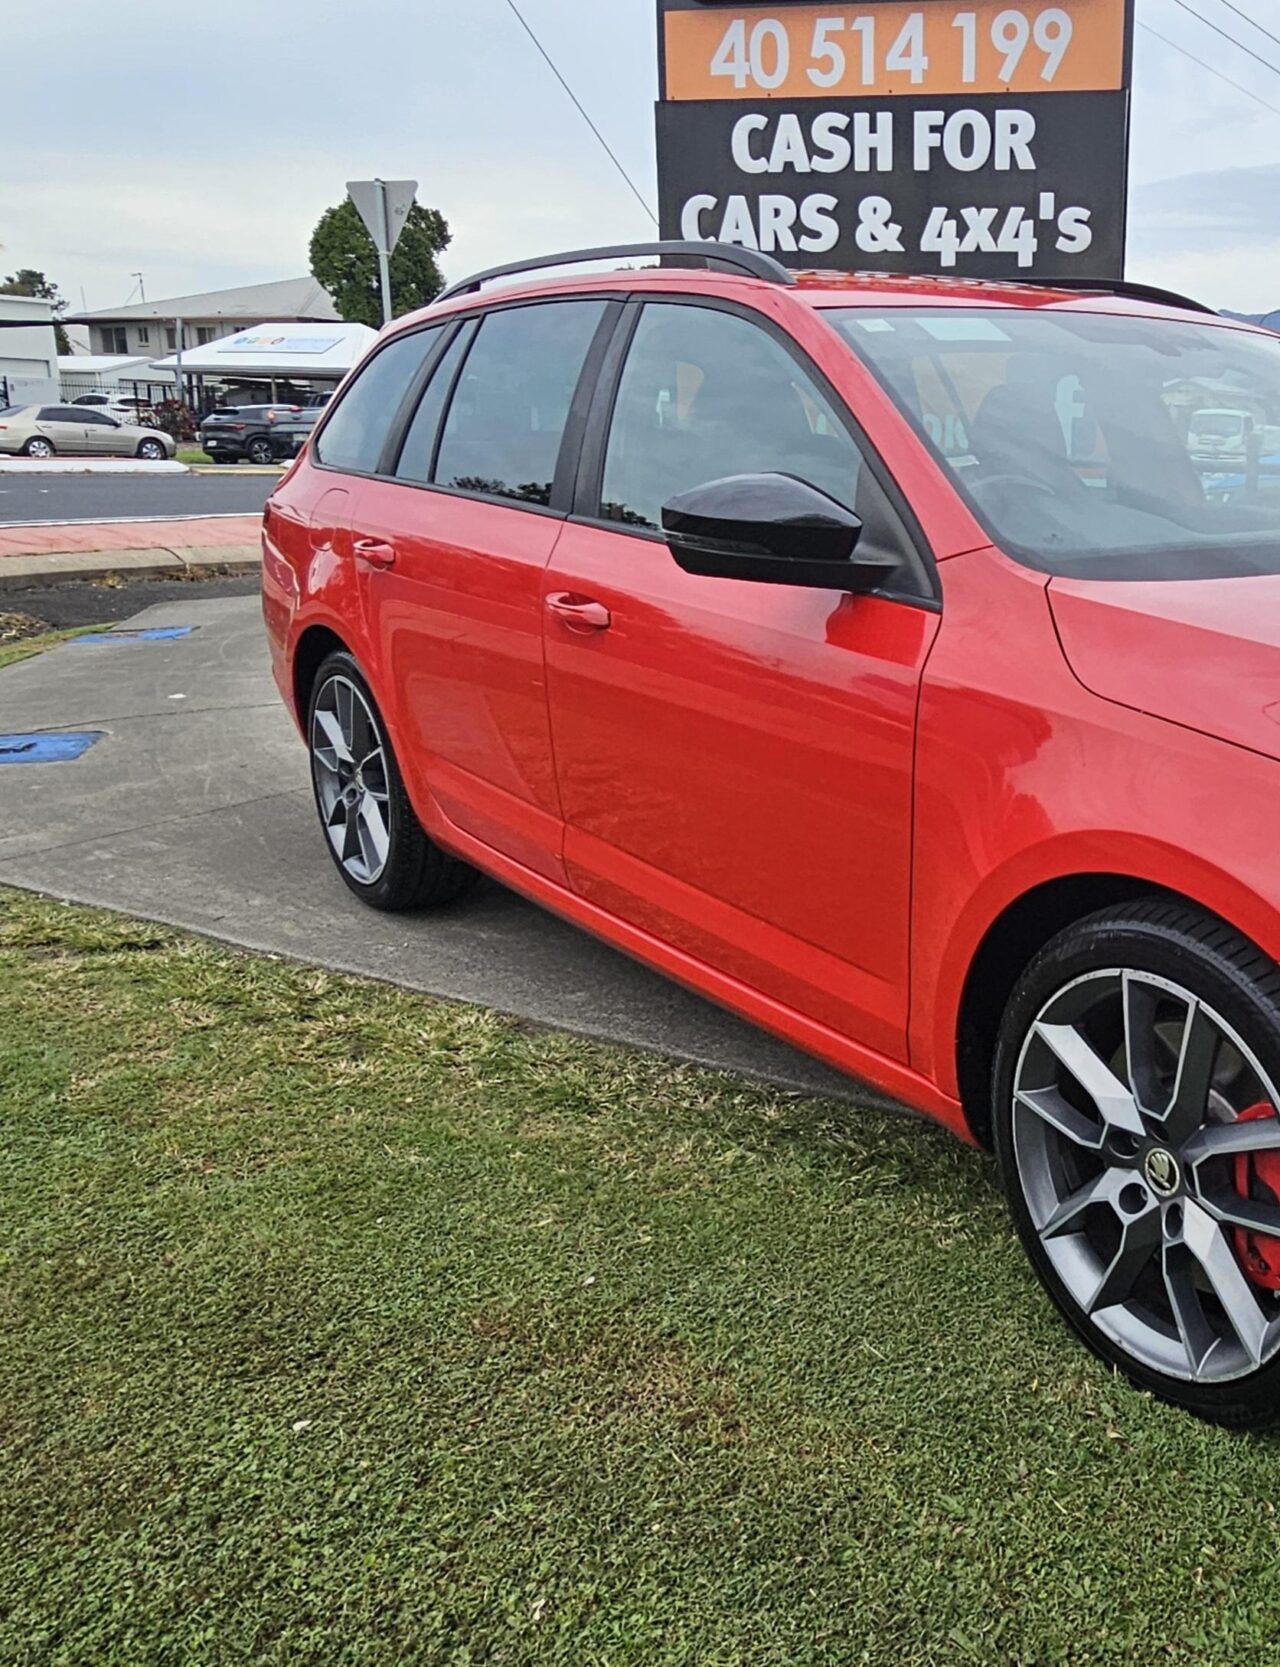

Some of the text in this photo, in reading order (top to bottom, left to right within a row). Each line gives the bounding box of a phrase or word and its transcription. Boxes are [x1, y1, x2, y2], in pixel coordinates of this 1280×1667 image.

[710, 8, 1073, 88] 40 514 199
[731, 109, 1036, 173] CASH FOR
[681, 193, 840, 253] CARS
[855, 195, 905, 252] &
